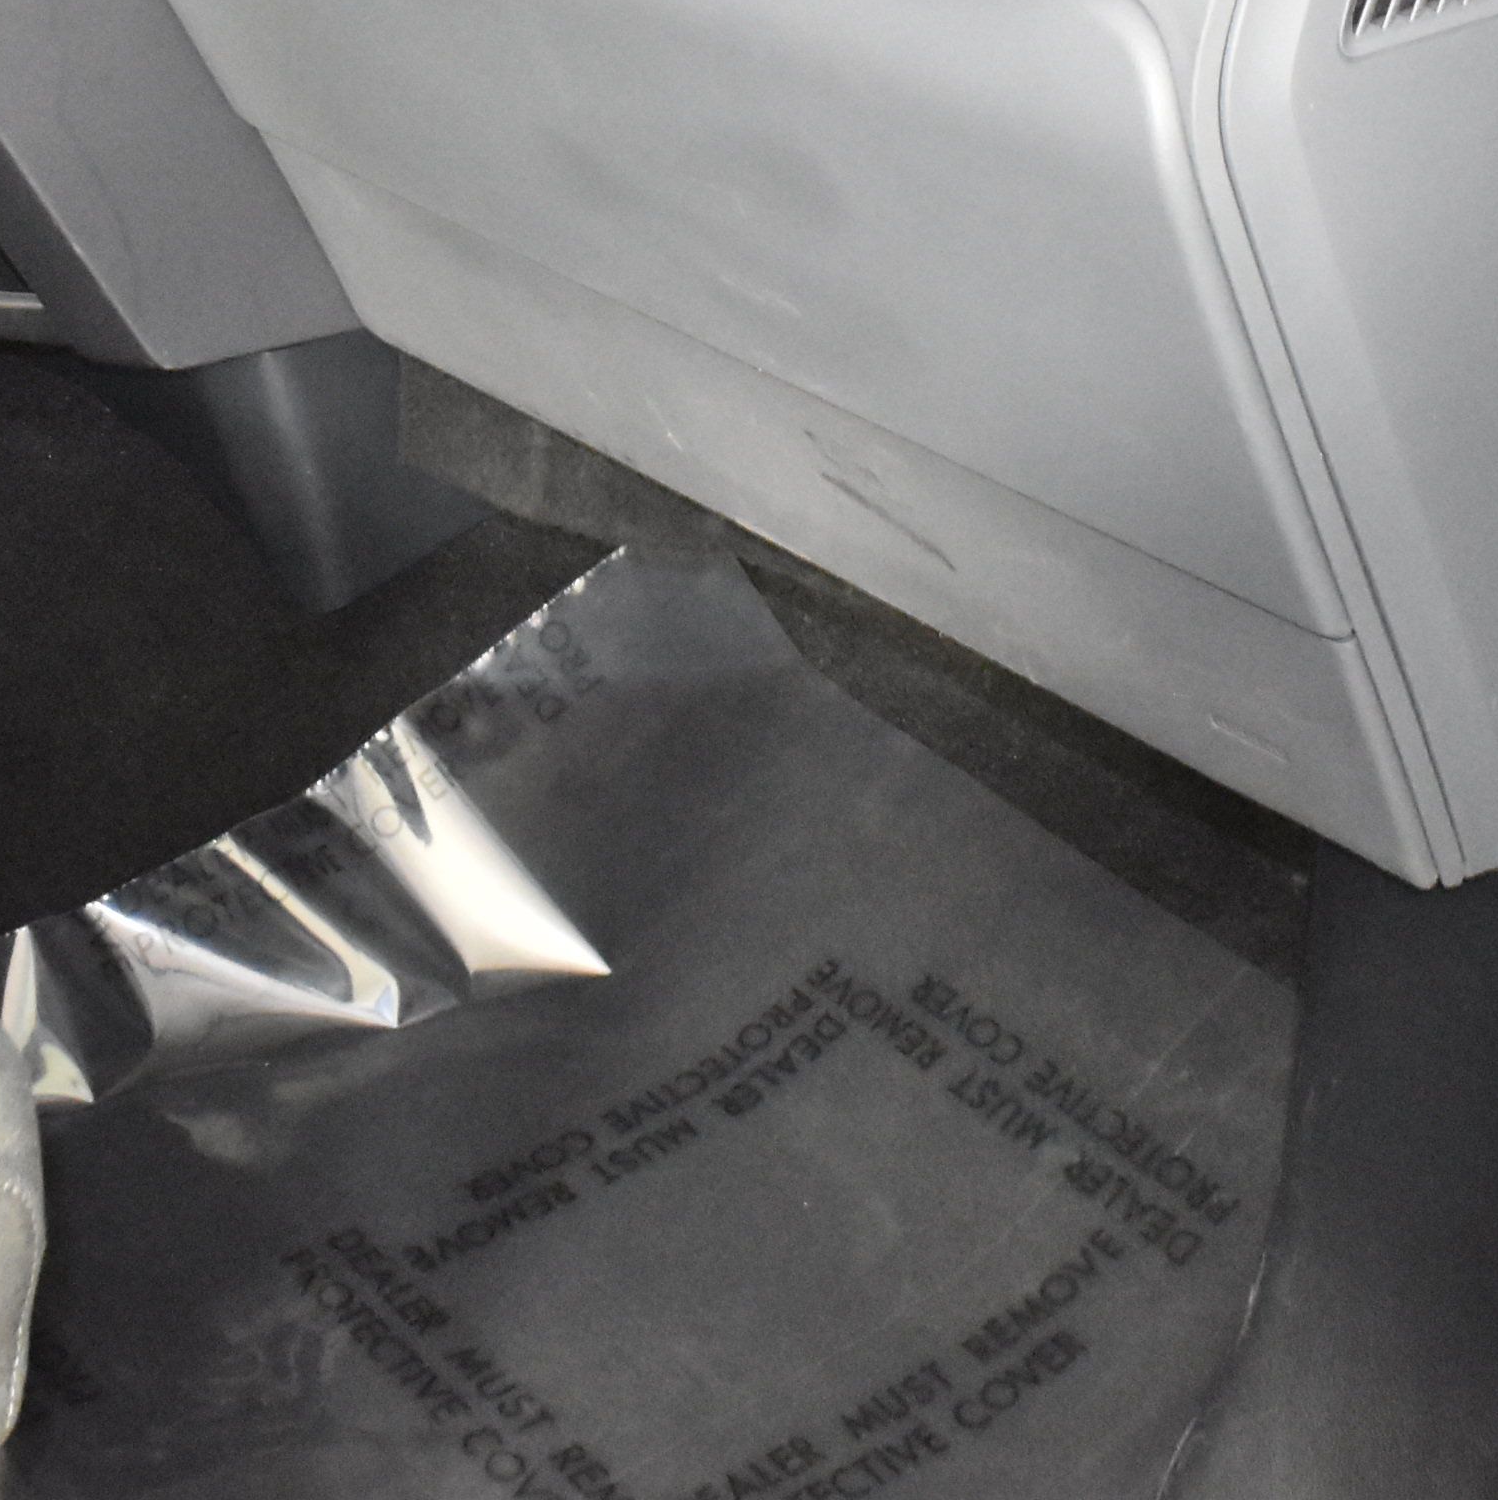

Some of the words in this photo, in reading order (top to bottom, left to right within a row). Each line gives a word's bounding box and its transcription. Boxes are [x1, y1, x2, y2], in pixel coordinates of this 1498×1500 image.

[601, 986, 813, 1135] PROTECTIVE
[712, 1011, 848, 1117] DEALER
[806, 959, 947, 1070] REMOVE
[912, 974, 1024, 1065] COVER
[591, 1117, 698, 1186] MUST
[947, 1070, 1057, 1150] MUST
[1023, 1059, 1241, 1226] PROTECTIVE
[462, 1129, 595, 1202] COVER
[1064, 1154, 1201, 1266] DEALER
[403, 1181, 577, 1272] REMOVE
[279, 1248, 471, 1426] PROTECTIVE
[327, 1227, 451, 1335] DEALER
[444, 1347, 556, 1432] MUST
[840, 1360, 952, 1441] MUST
[961, 1228, 1126, 1366] REMOVE
[953, 1330, 1089, 1431] COVER
